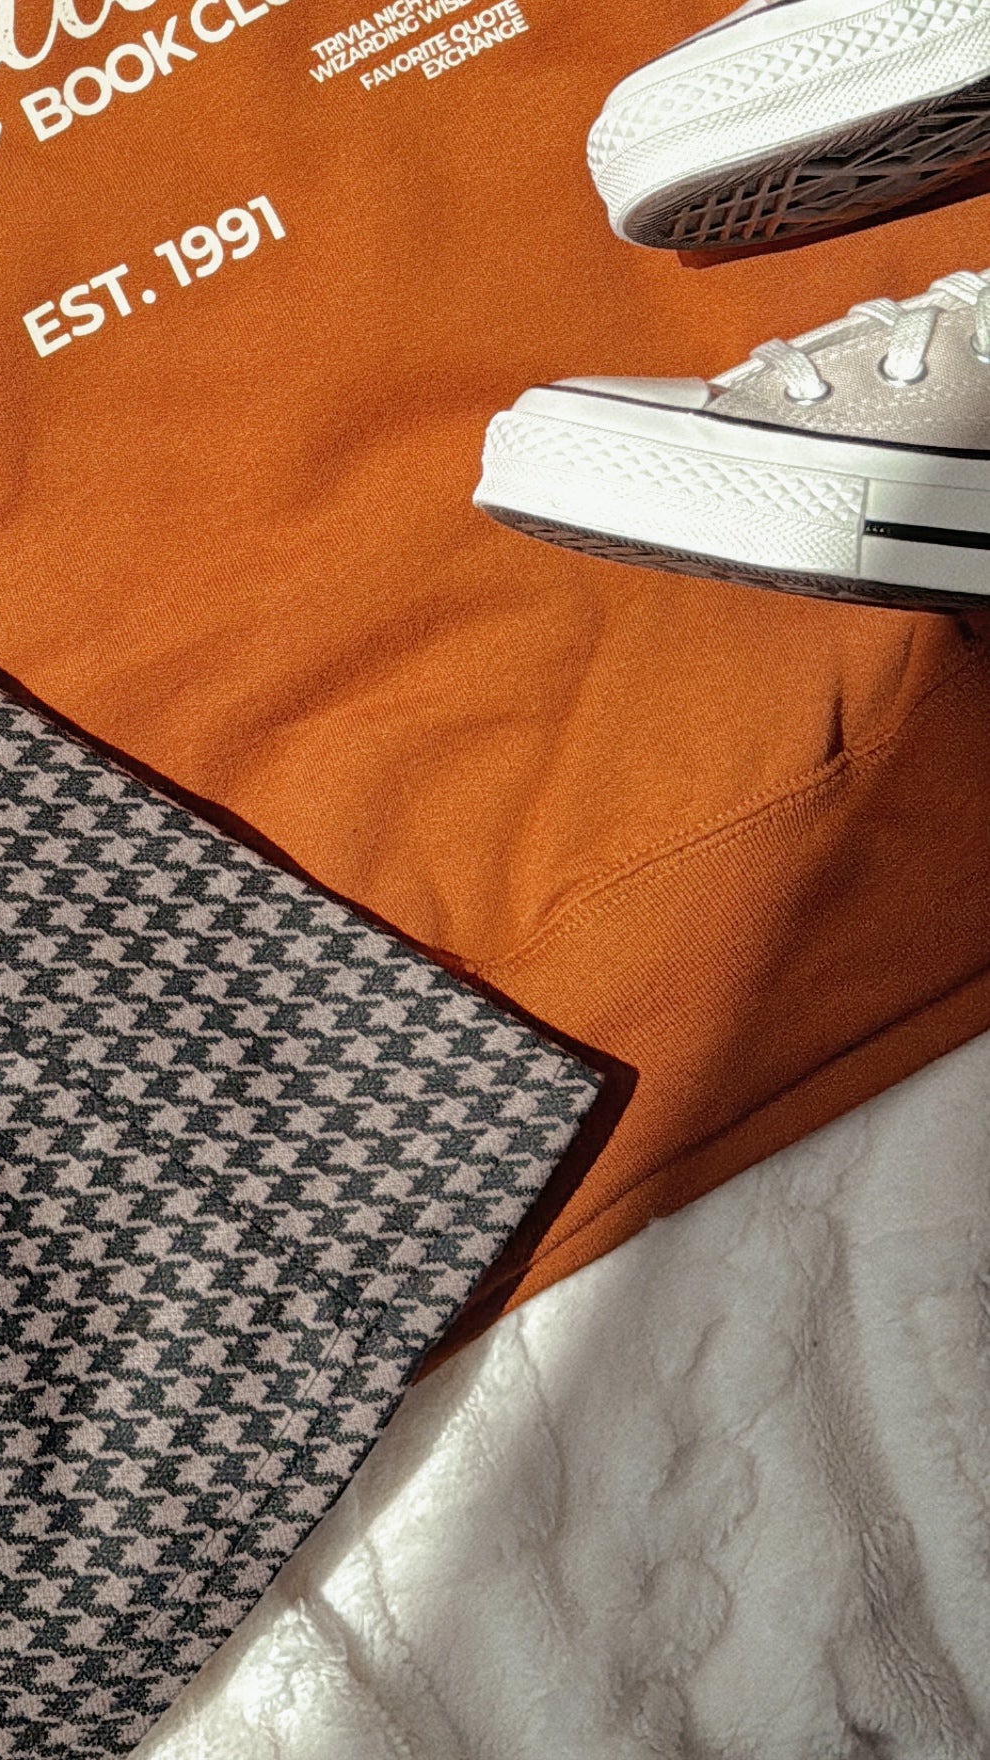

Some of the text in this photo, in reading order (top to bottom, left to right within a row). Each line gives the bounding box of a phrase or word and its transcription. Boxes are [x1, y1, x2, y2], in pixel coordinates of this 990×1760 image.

[308, 15, 420, 84] WIZARDING
[311, 18, 376, 61] TRIVIA
[359, 31, 451, 91] FAVORITE
[419, 14, 530, 81] EXCHANGE
[19, 15, 199, 143] BOOK
[22, 194, 287, 358] EST. 1991
